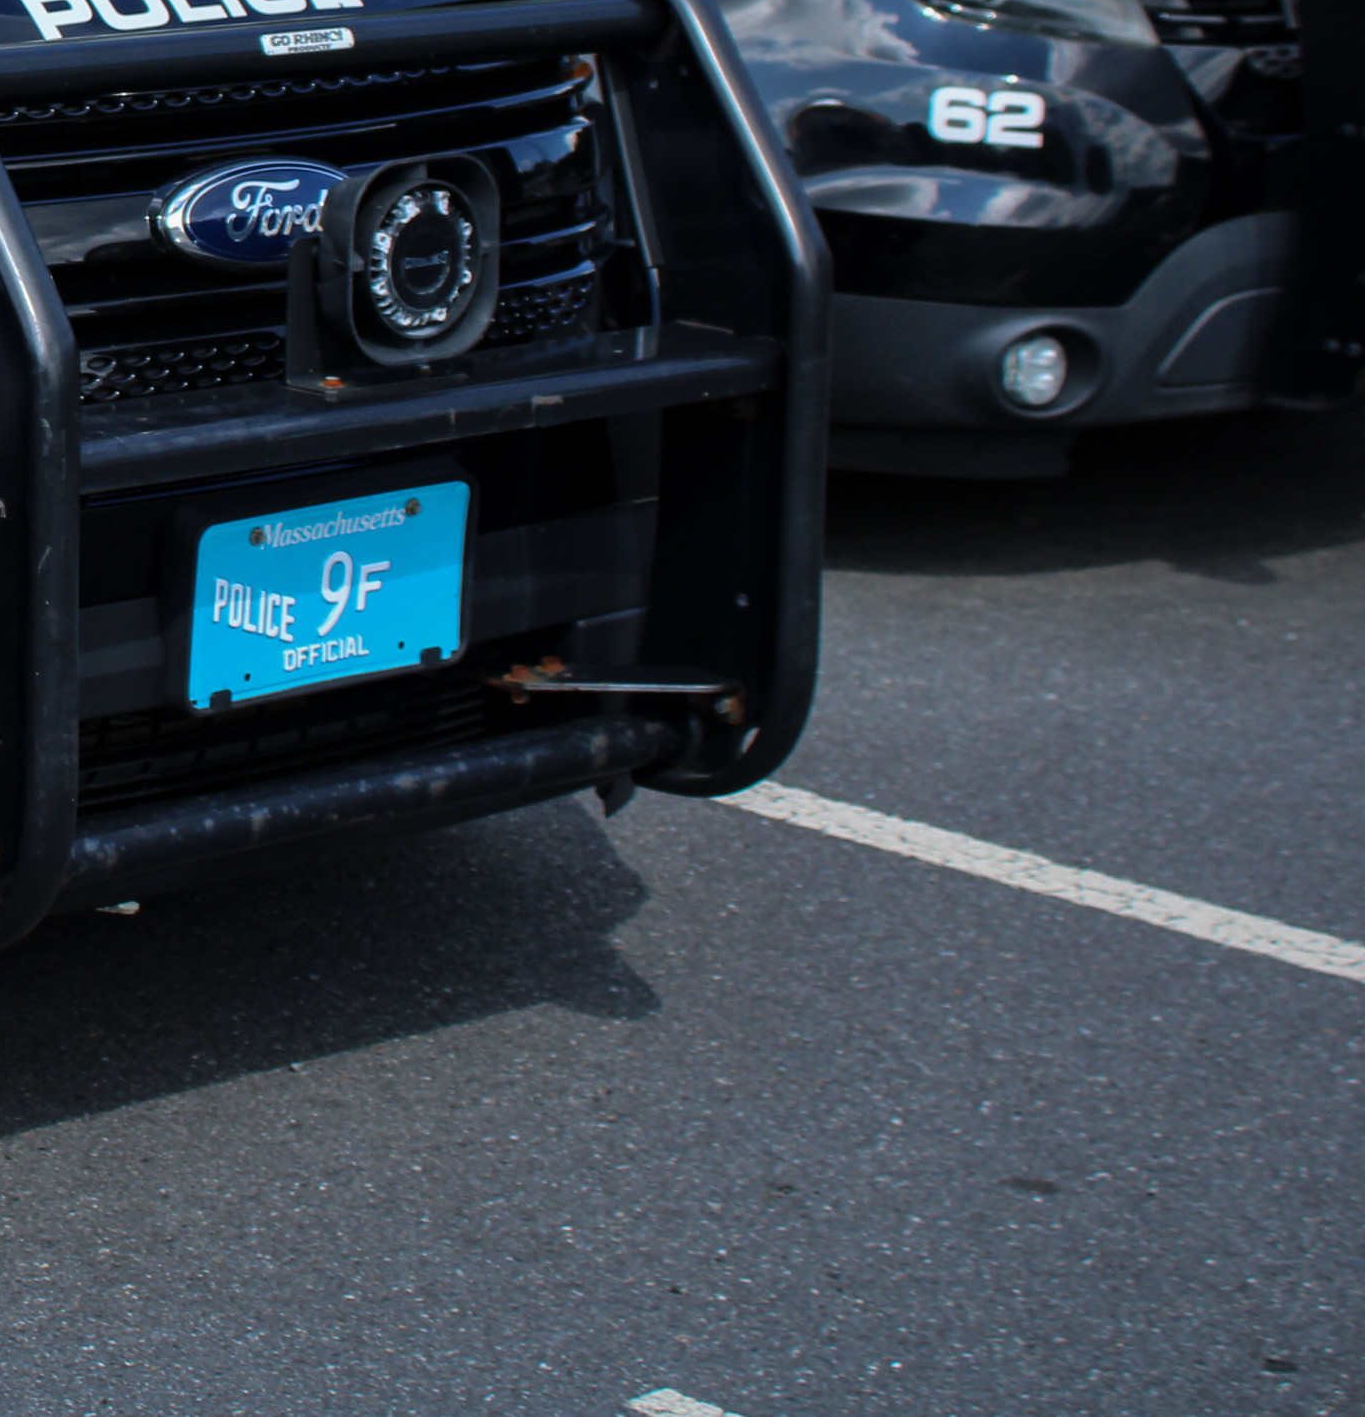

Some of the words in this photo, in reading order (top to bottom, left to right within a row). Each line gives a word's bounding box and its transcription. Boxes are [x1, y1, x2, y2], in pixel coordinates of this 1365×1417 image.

[928, 86, 1045, 149] 62
[226, 178, 328, 243] Ford
[259, 504, 407, 550] Massachusetts
[213, 578, 296, 643] POLICE
[318, 551, 391, 638] 9F
[283, 634, 370, 672] OFFICIAL
